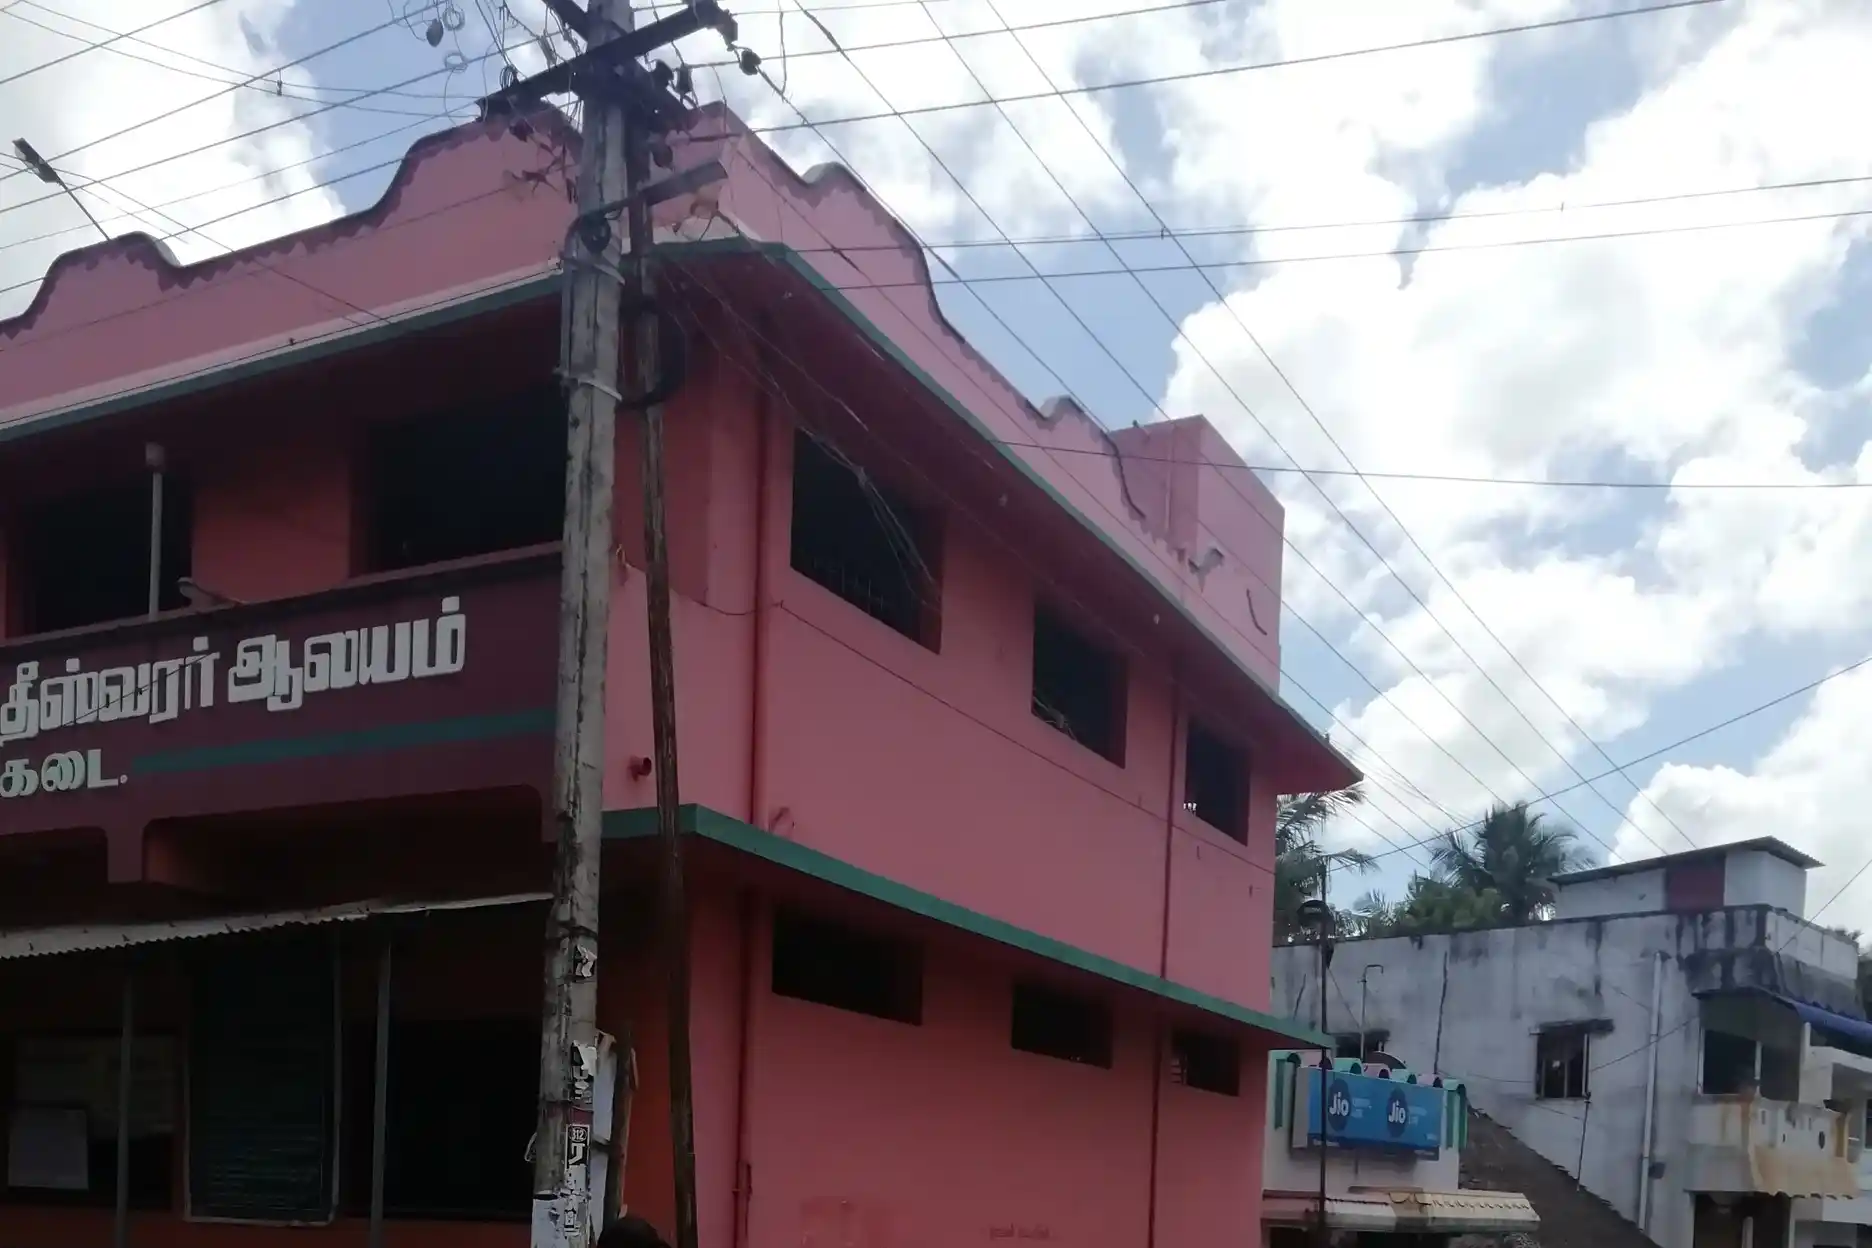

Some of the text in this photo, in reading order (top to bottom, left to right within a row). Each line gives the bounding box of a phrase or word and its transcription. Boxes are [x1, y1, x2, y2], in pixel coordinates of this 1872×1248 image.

[228, 596, 466, 712] ஆலயம்
[1328, 1091, 1350, 1117] Jio
[1387, 1101, 1407, 1125] Jio
